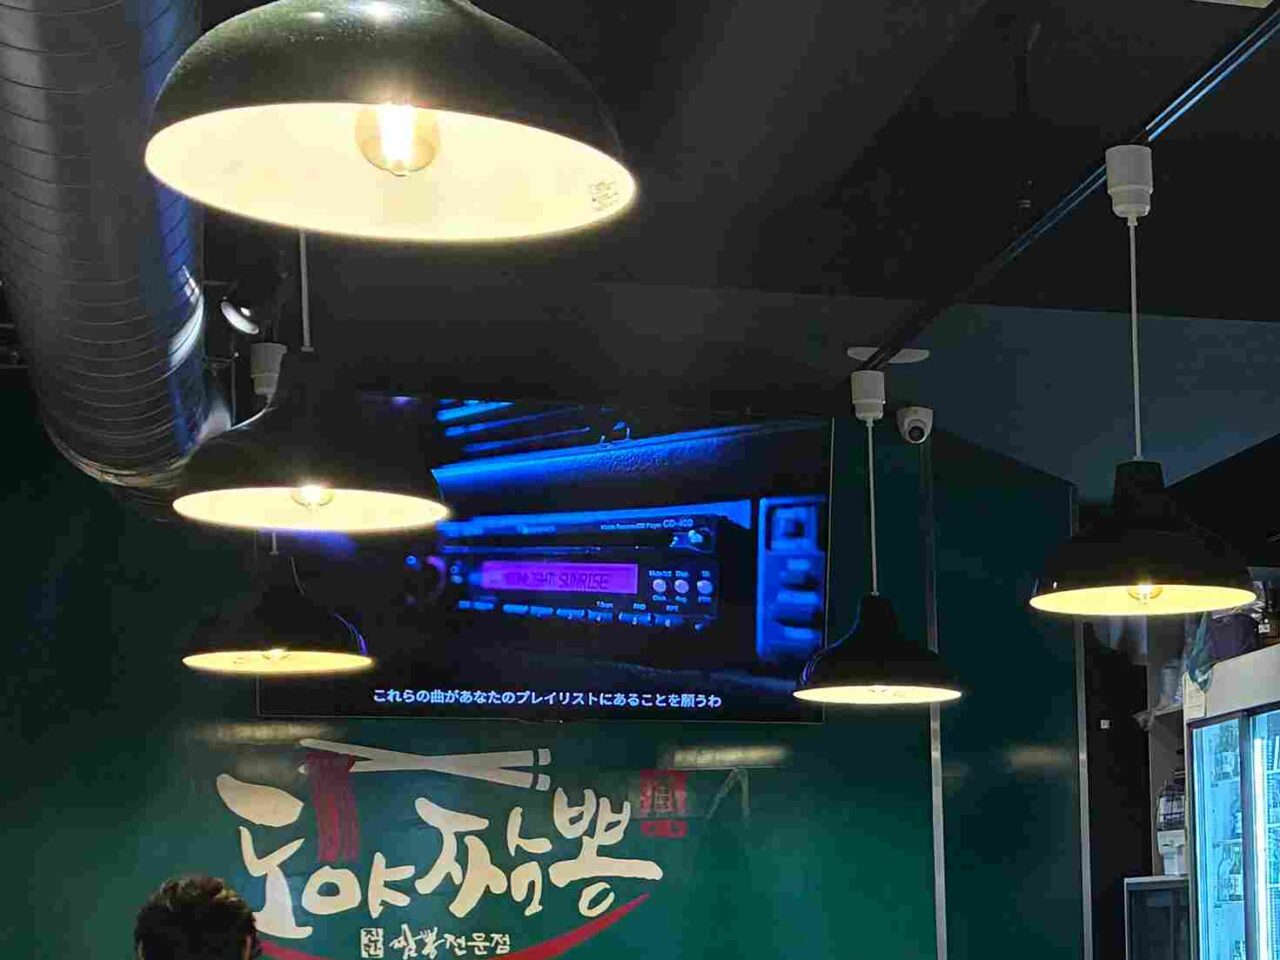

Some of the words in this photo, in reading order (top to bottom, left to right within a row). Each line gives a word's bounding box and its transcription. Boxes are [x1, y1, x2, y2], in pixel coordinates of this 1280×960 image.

[373, 688, 723, 708] これらの曲があなたのプレイリストにあることを願うわ
